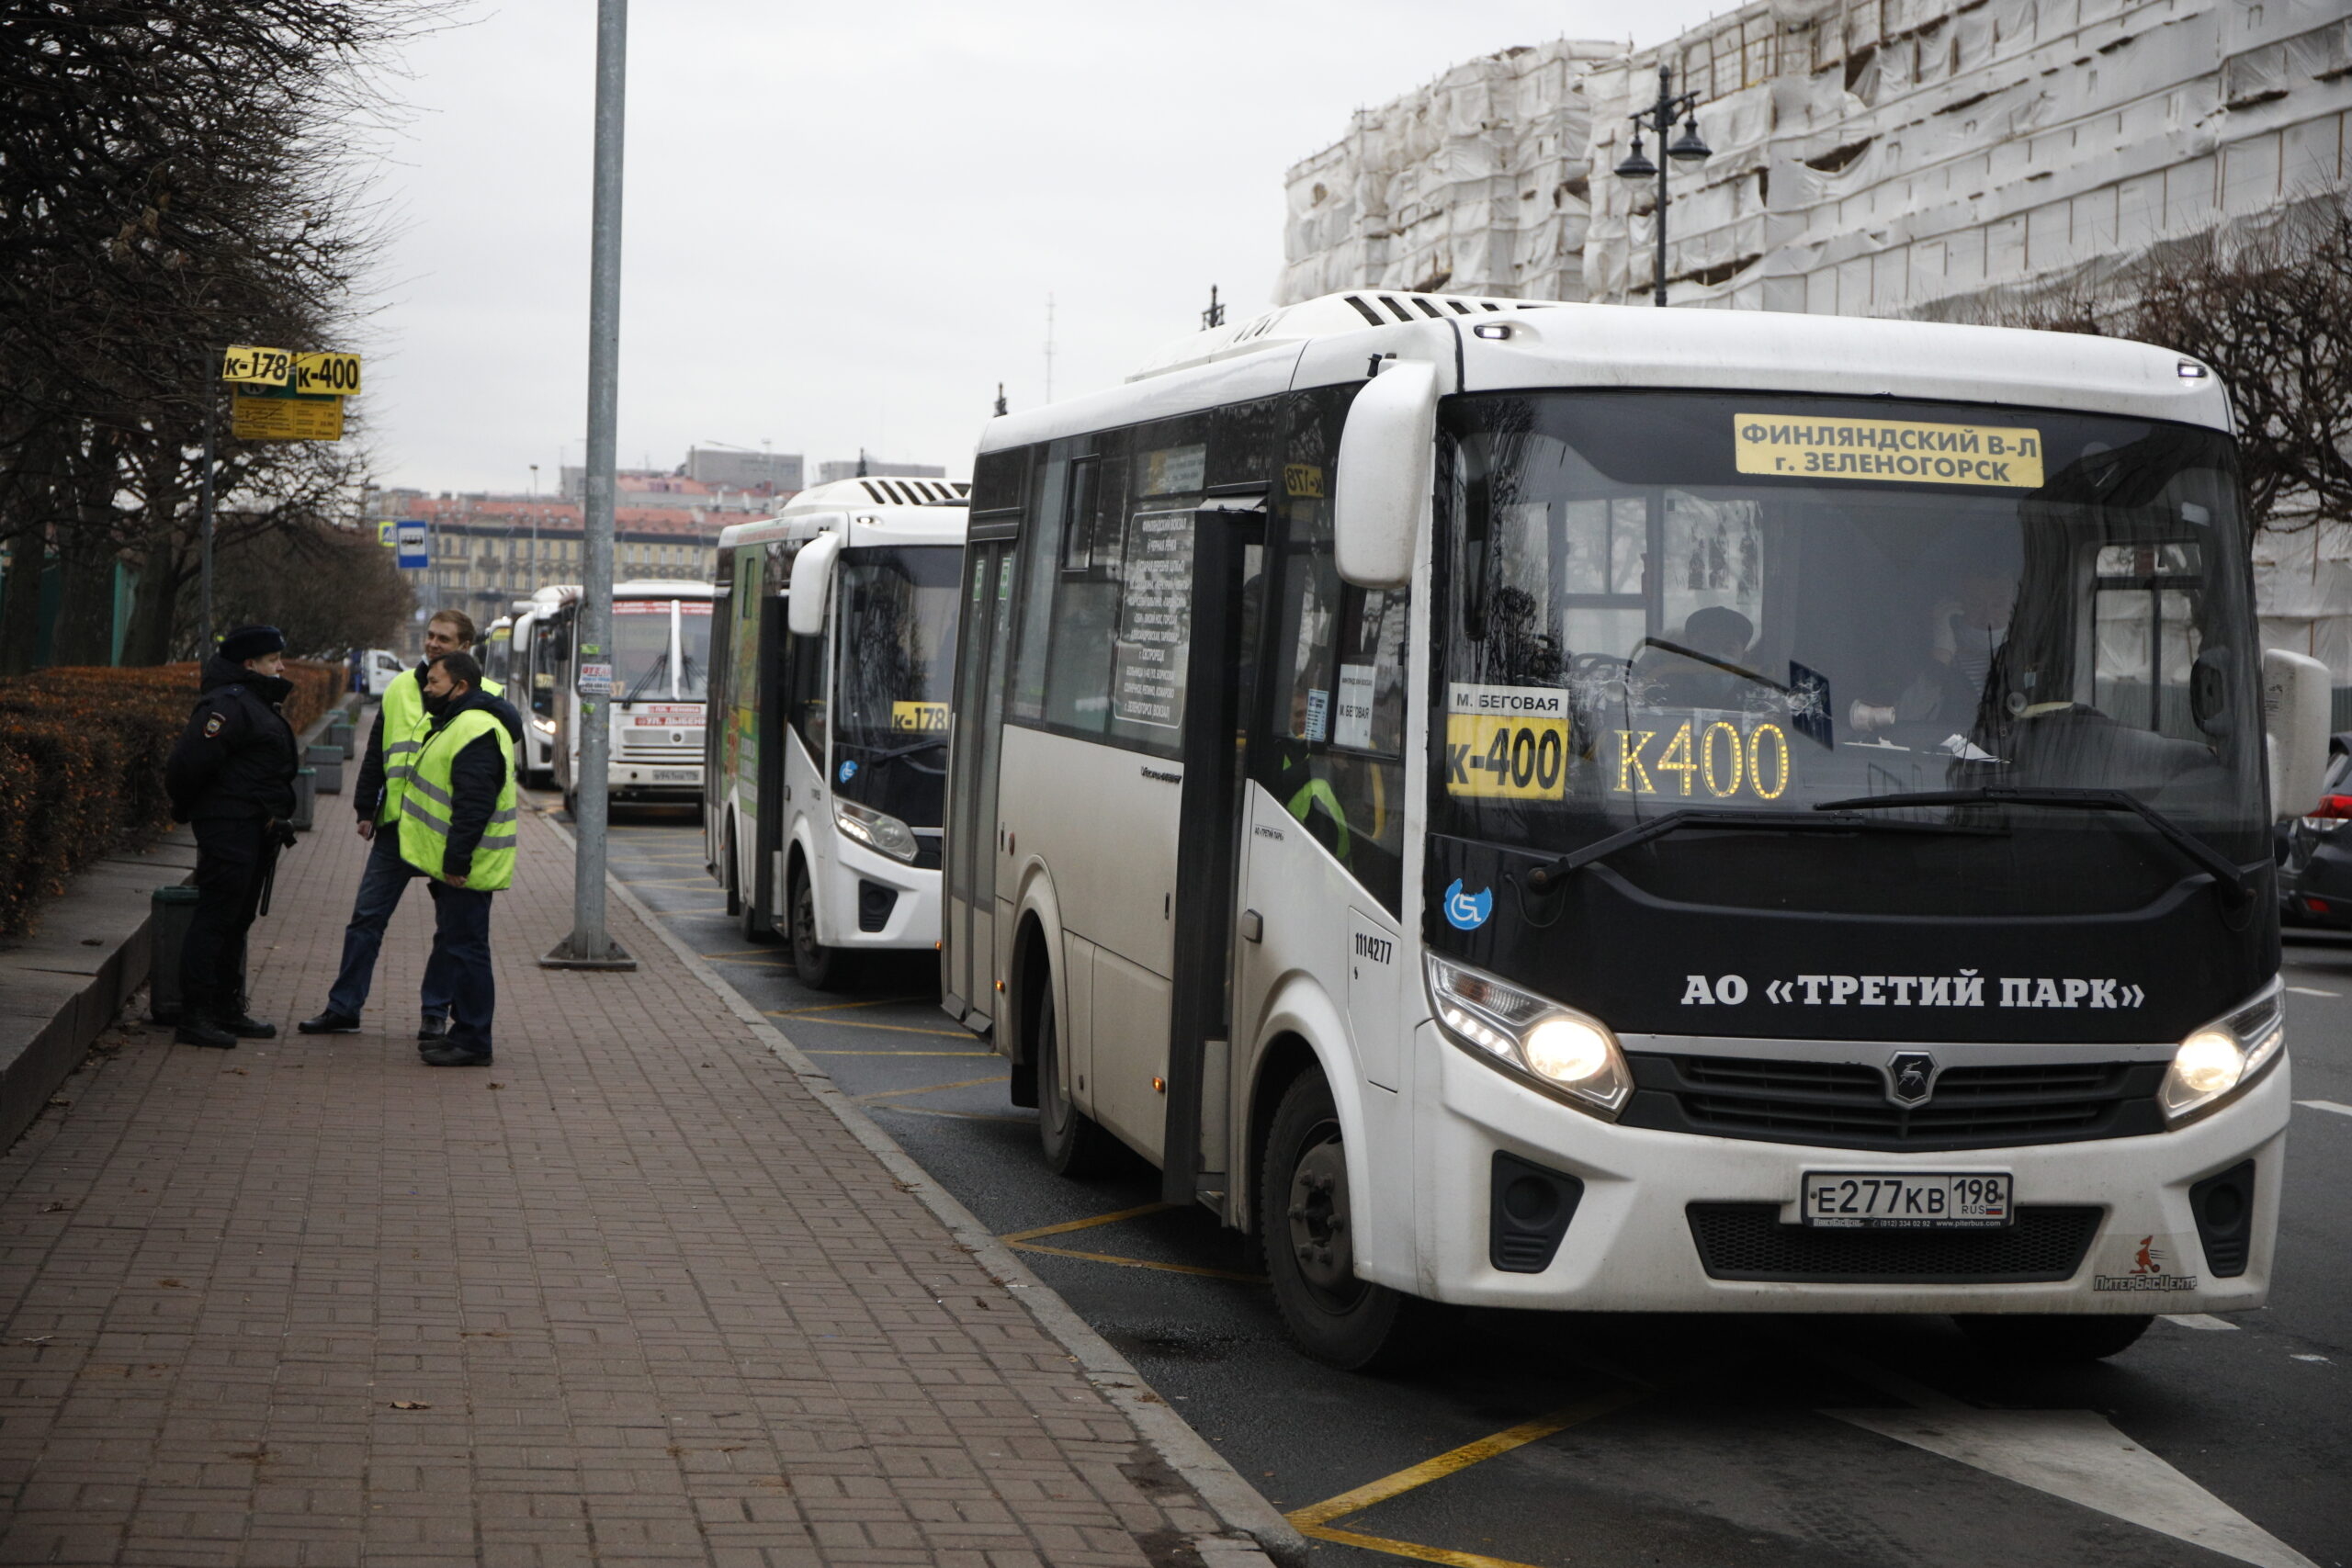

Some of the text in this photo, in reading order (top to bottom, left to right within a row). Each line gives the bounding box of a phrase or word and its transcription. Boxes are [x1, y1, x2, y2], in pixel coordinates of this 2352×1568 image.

[1742, 423, 2038, 457] ФИНЛЯНДСКИЙ В-Л
[1775, 452, 2010, 483] г. ЗЕЛЕНОГОРСК
[1456, 693, 1559, 712] М. БЕГОВАЯ
[1613, 719, 1790, 800] К400
[1355, 932, 1393, 965] 1114277
[1680, 968, 2145, 1009] АО «ТРЕТИЙ ПАРК»
[1936, 1220, 2002, 1228] www.piterbus.com
[1962, 1204, 1985, 1214] RUS
